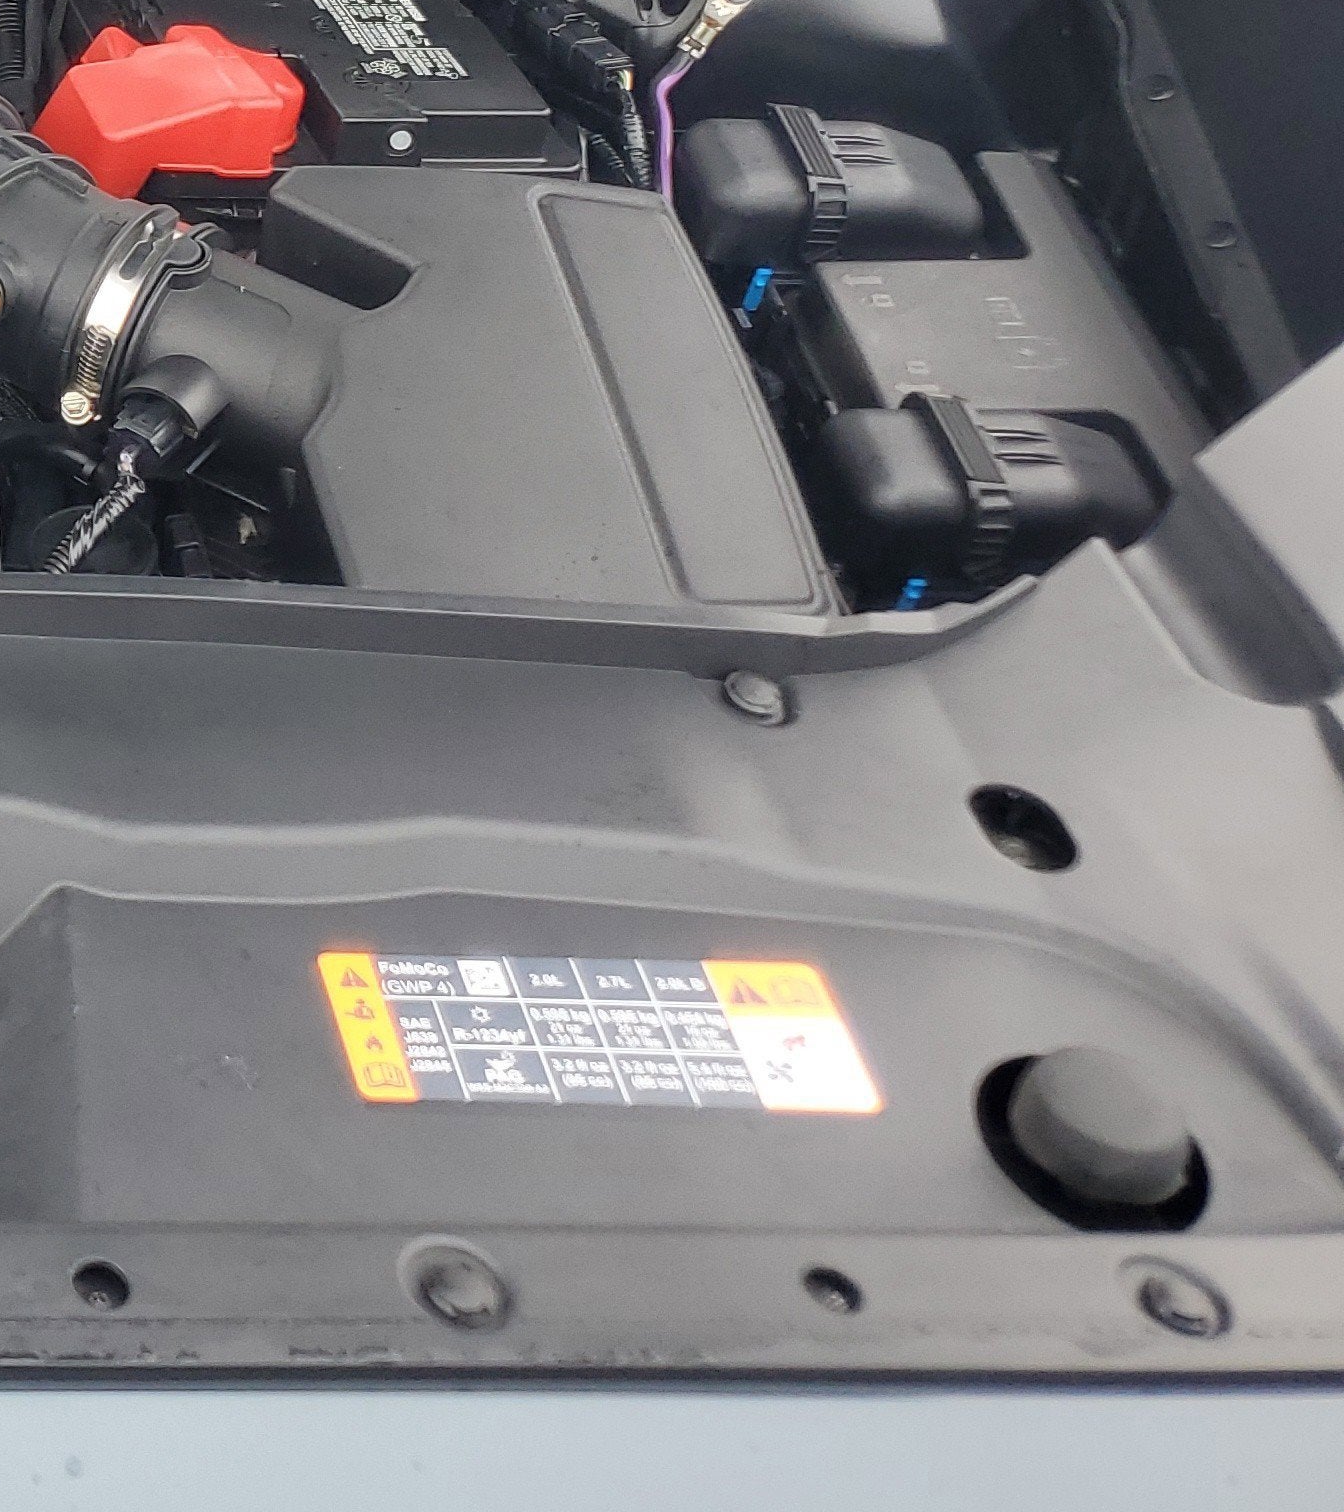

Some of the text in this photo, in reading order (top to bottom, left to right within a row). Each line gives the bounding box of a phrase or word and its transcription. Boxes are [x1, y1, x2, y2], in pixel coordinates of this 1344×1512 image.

[377, 961, 450, 976] FoMoCo
[381, 979, 457, 997] (GWP 4)
[452, 1027, 527, 1045] R-1234yf
